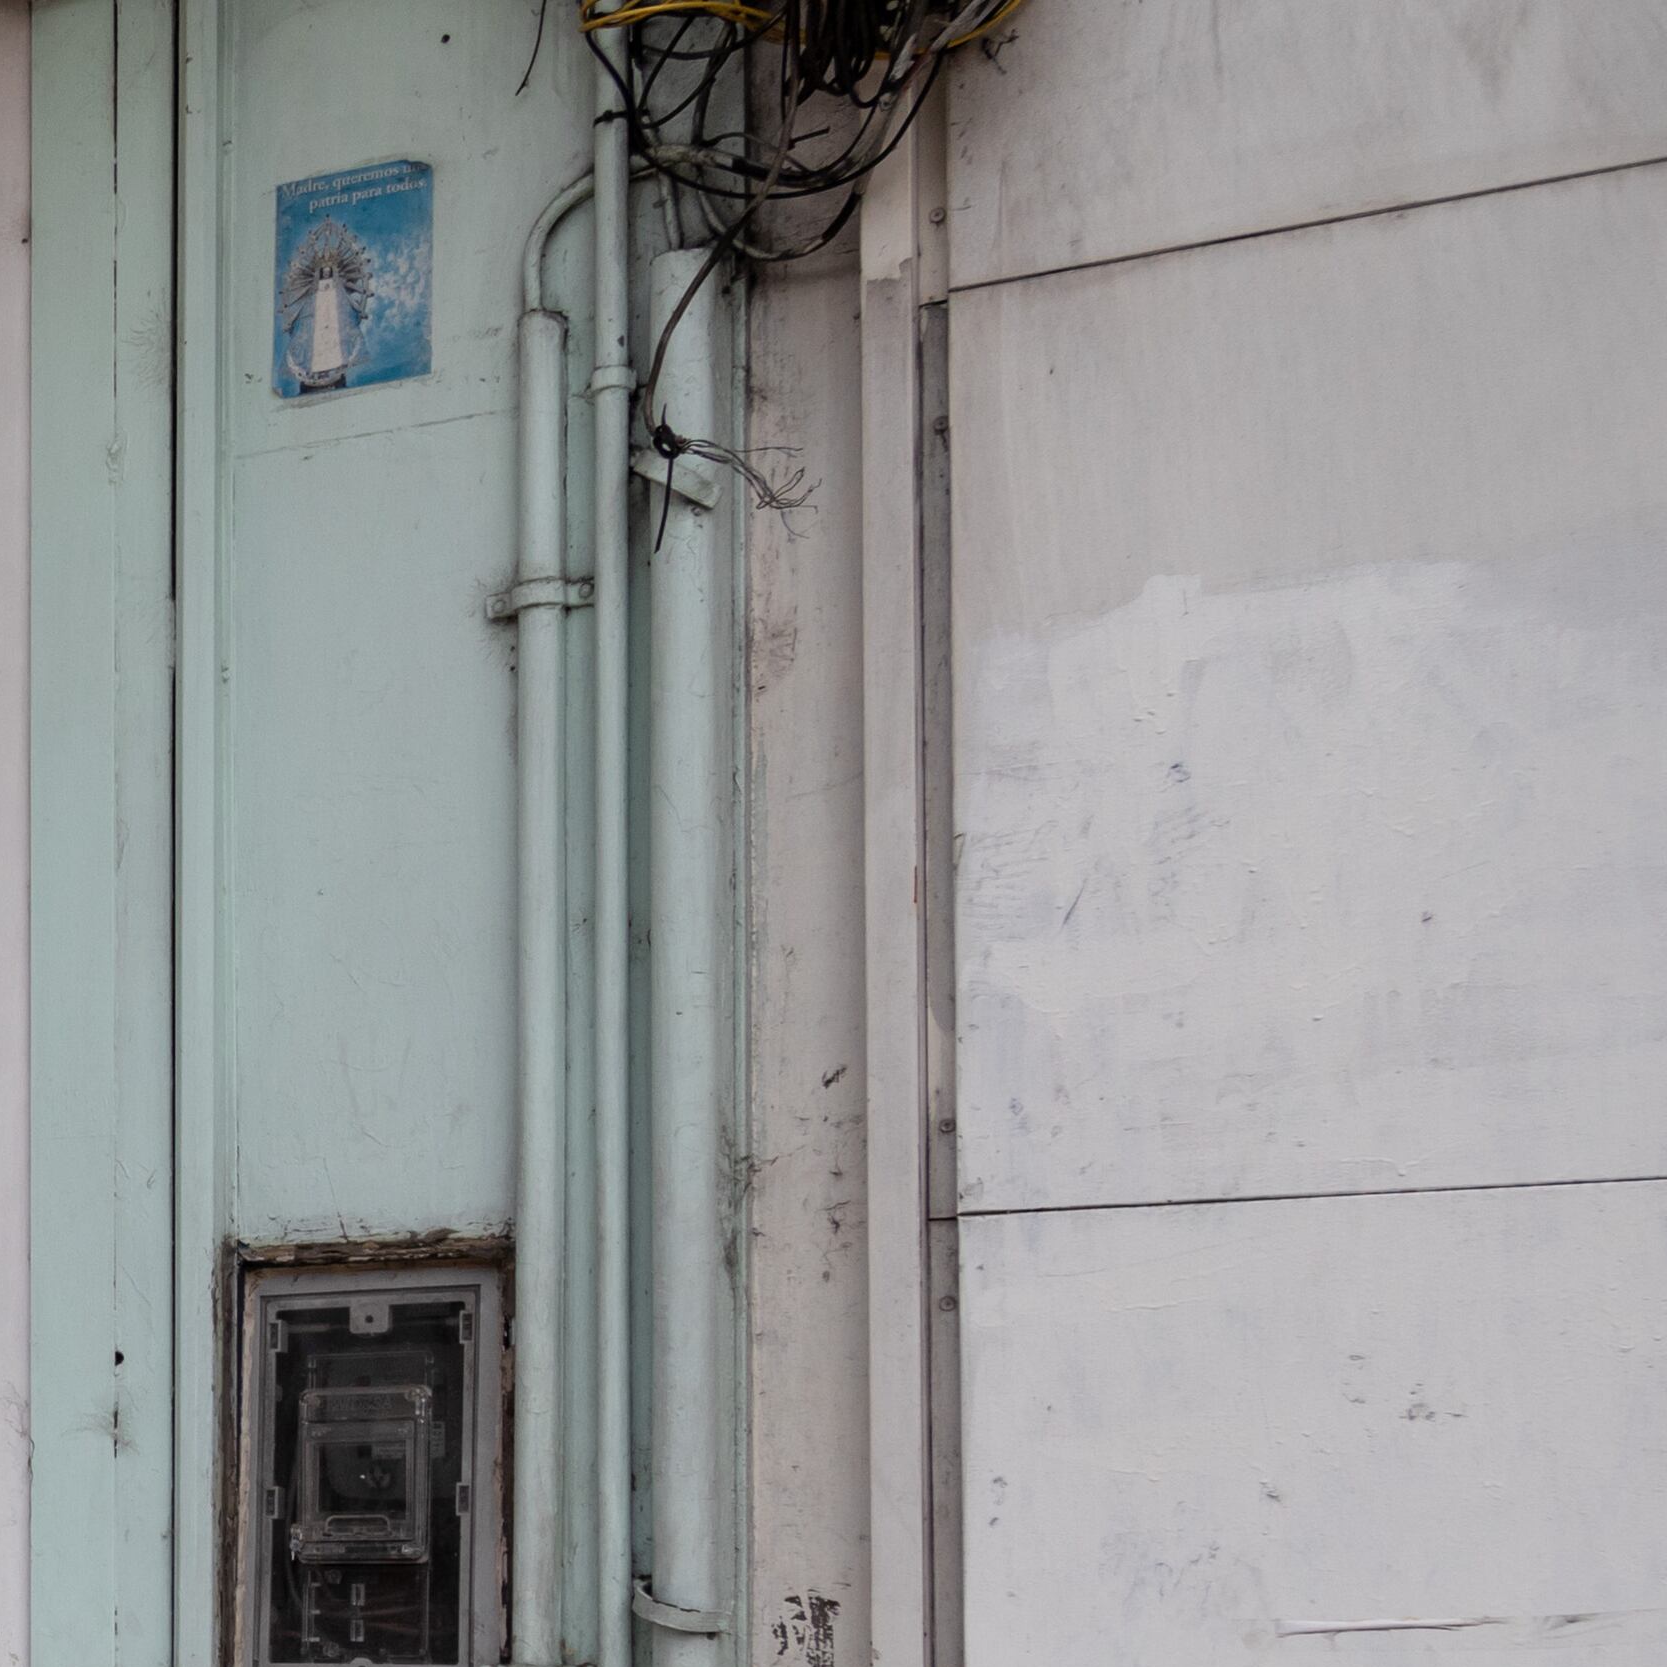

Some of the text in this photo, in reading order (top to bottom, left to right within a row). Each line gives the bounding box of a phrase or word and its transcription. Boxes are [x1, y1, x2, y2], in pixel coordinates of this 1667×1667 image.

[333, 168, 400, 189] queremos
[309, 193, 349, 213] patria
[352, 187, 382, 205] para
